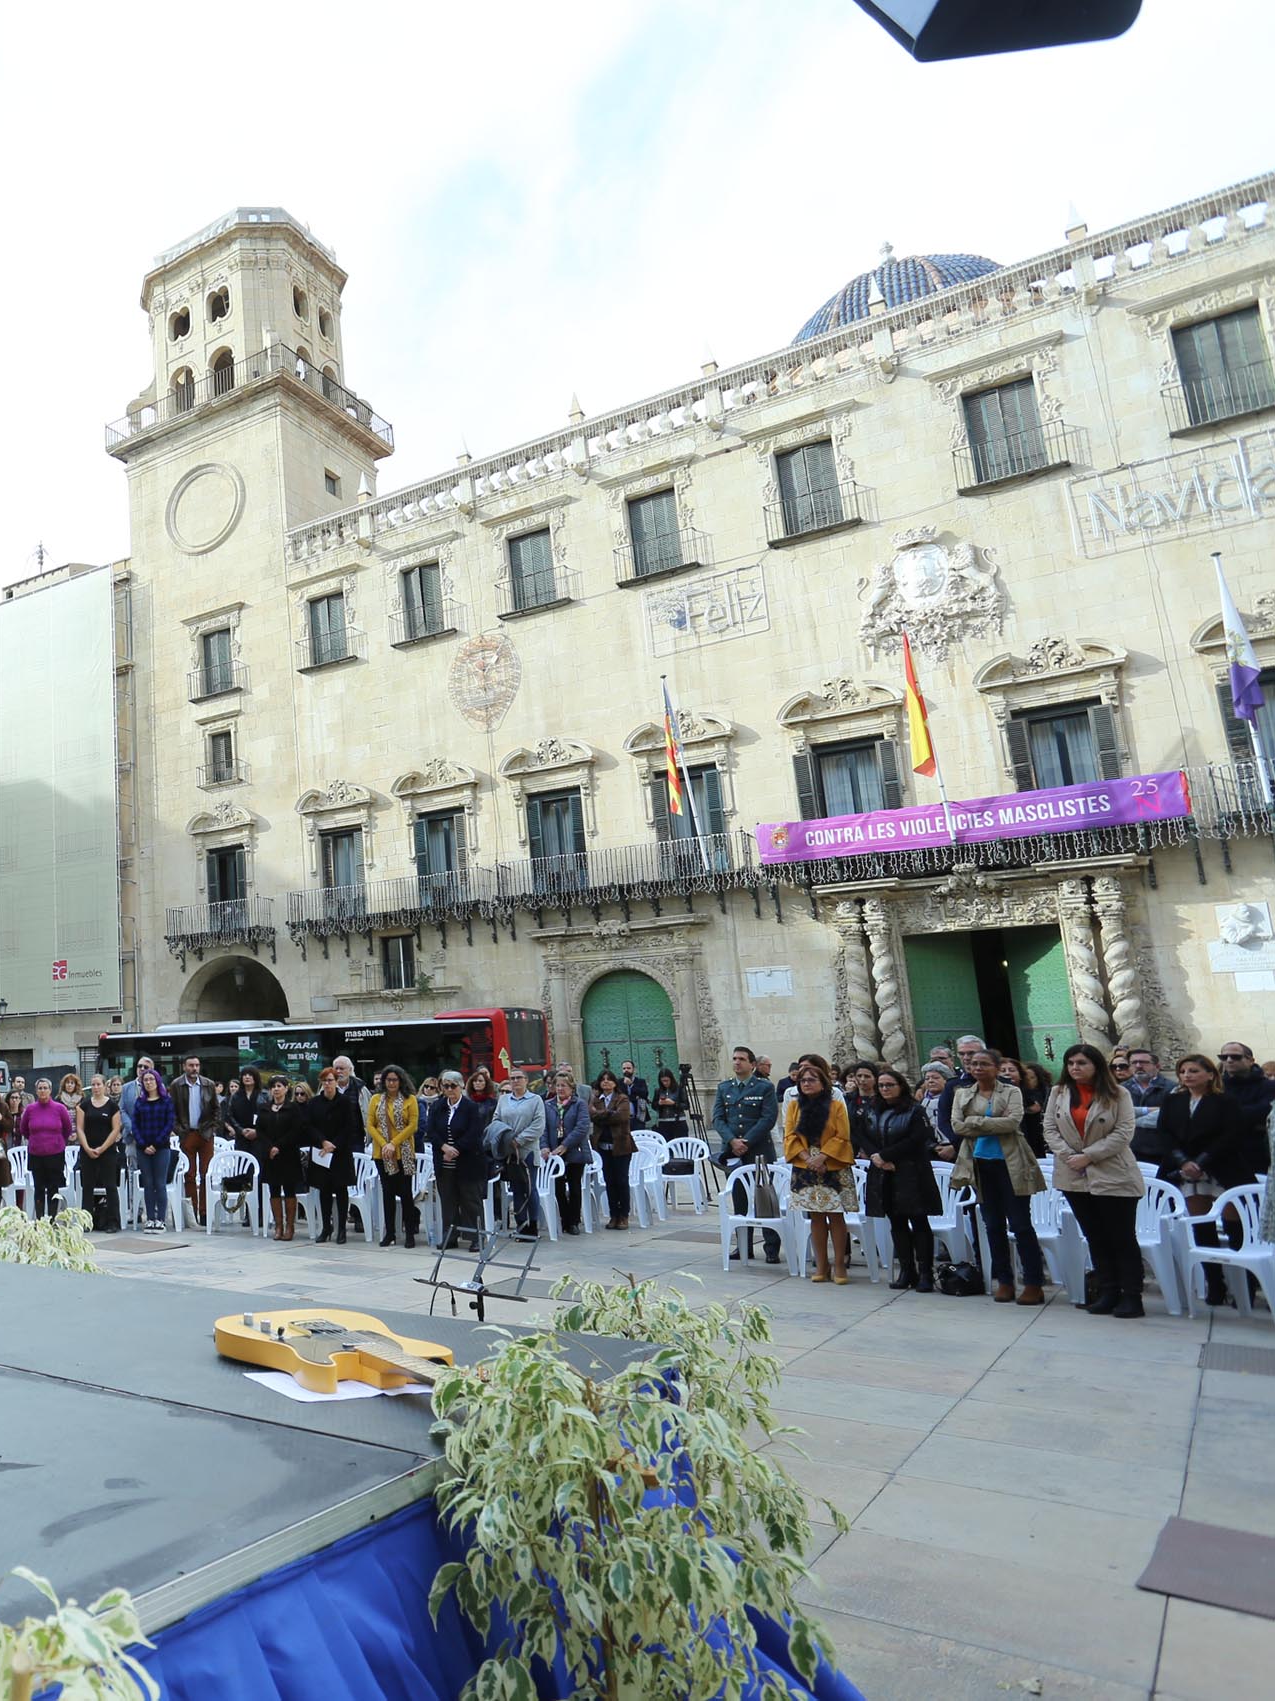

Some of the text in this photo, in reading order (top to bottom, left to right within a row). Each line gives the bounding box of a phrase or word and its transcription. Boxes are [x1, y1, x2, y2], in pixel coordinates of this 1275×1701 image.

[1129, 778, 1159, 797] 25
[1133, 794, 1163, 817] N
[804, 825, 865, 848] CONTRA
[868, 821, 897, 841] LES
[999, 793, 1112, 826] MASCLISTES
[68, 968, 103, 980] Inmuebles
[344, 1028, 385, 1038] masatusa
[276, 1041, 319, 1050] VITARA
